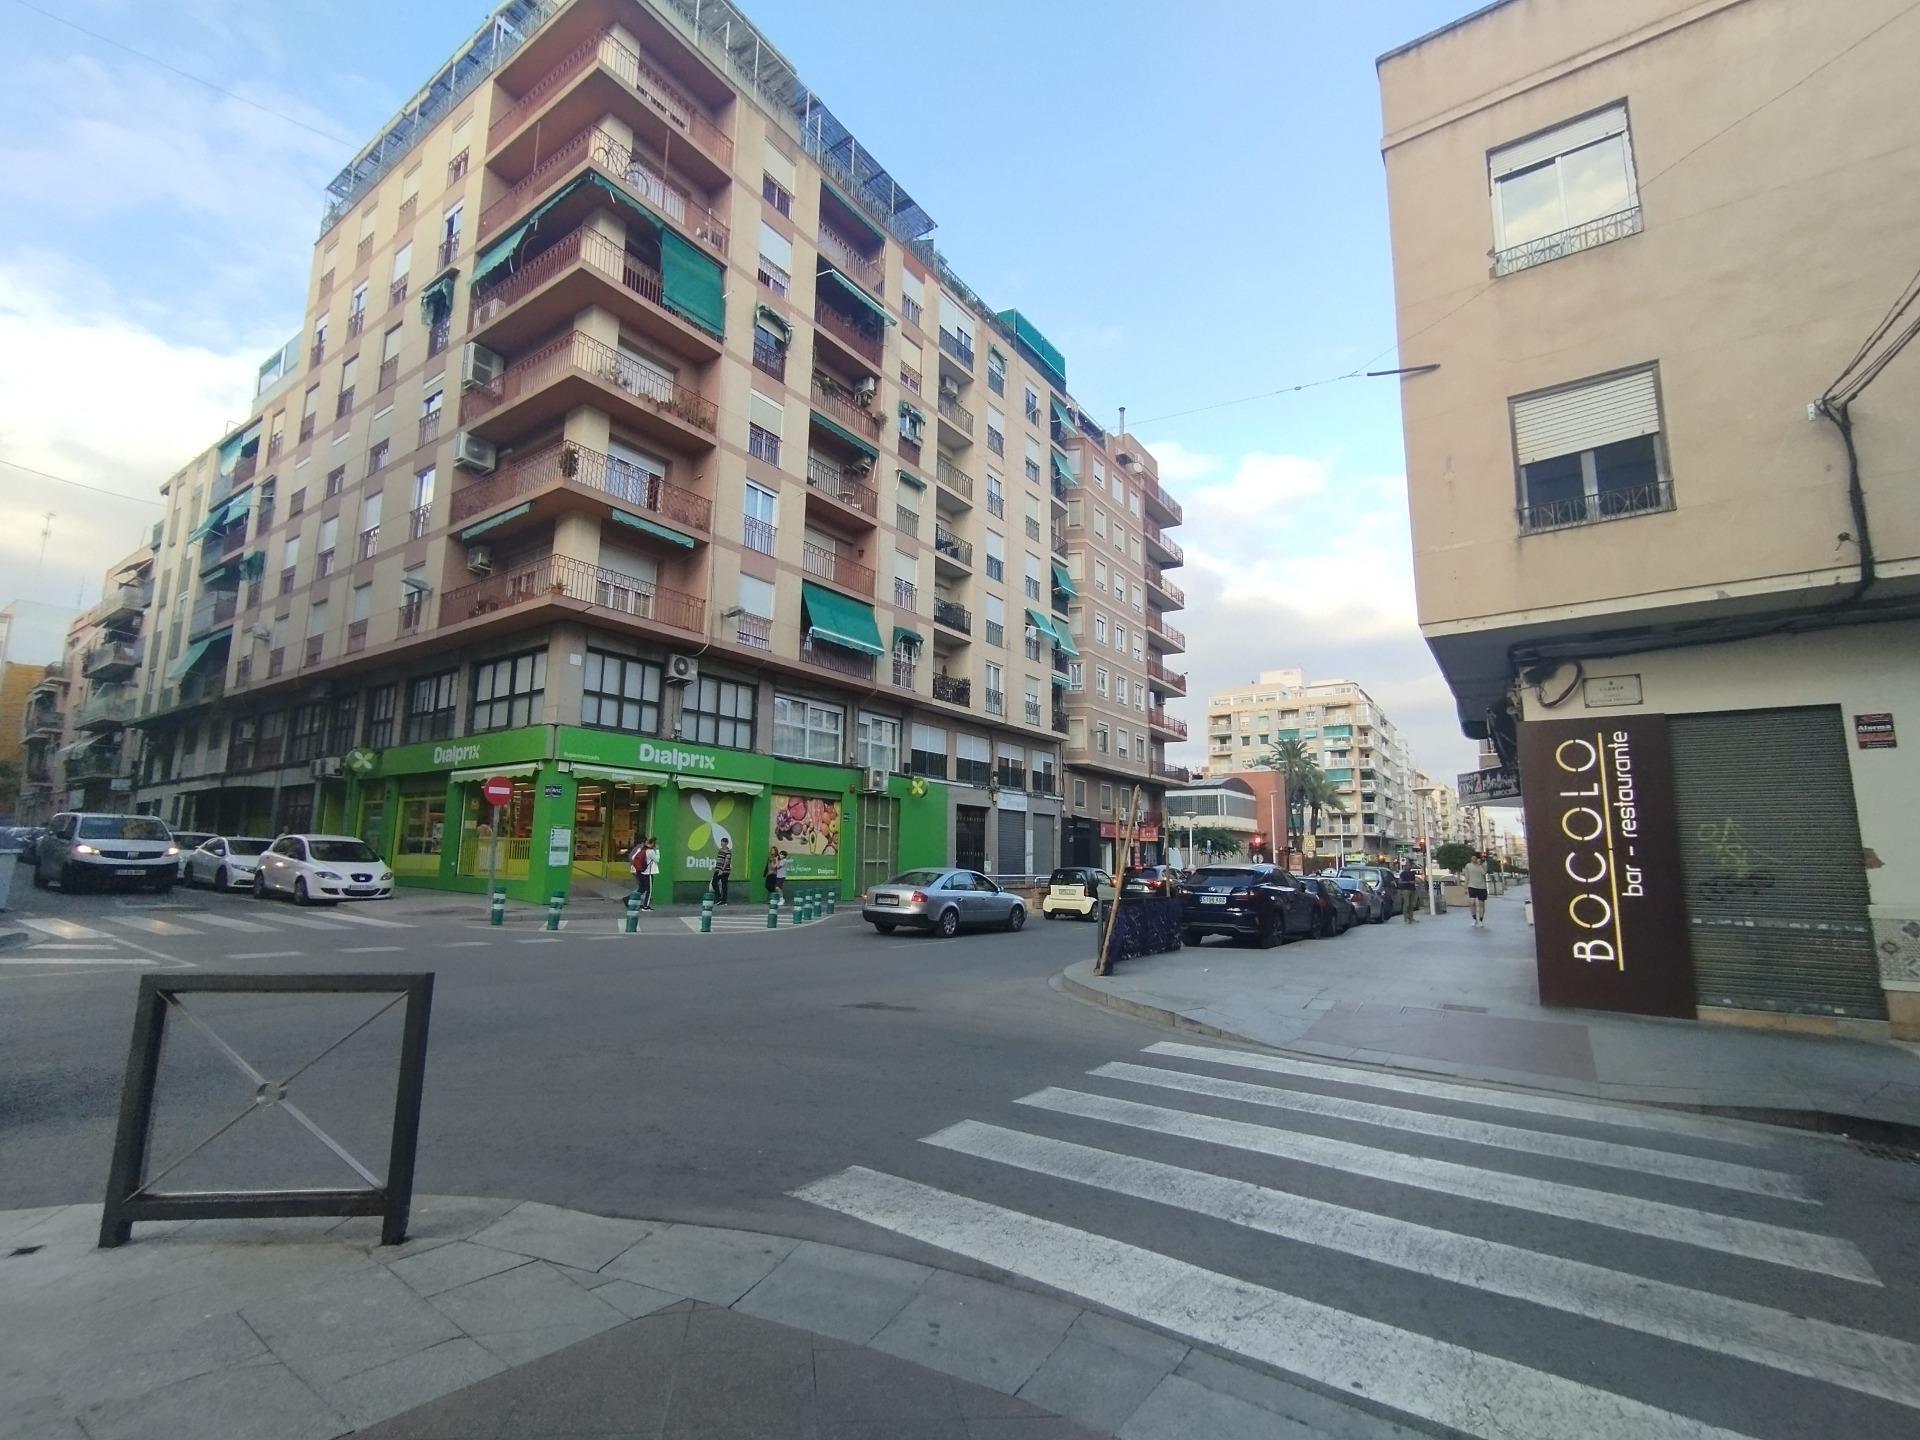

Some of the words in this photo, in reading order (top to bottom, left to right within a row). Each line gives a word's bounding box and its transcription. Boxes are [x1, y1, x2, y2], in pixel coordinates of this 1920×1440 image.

[433, 744, 480, 766] Dialprix
[639, 743, 716, 771] Dialprix
[1608, 731, 1638, 837] restaurante
[1555, 739, 1615, 962] BOCOLO
[1621, 864, 1643, 896] bar
